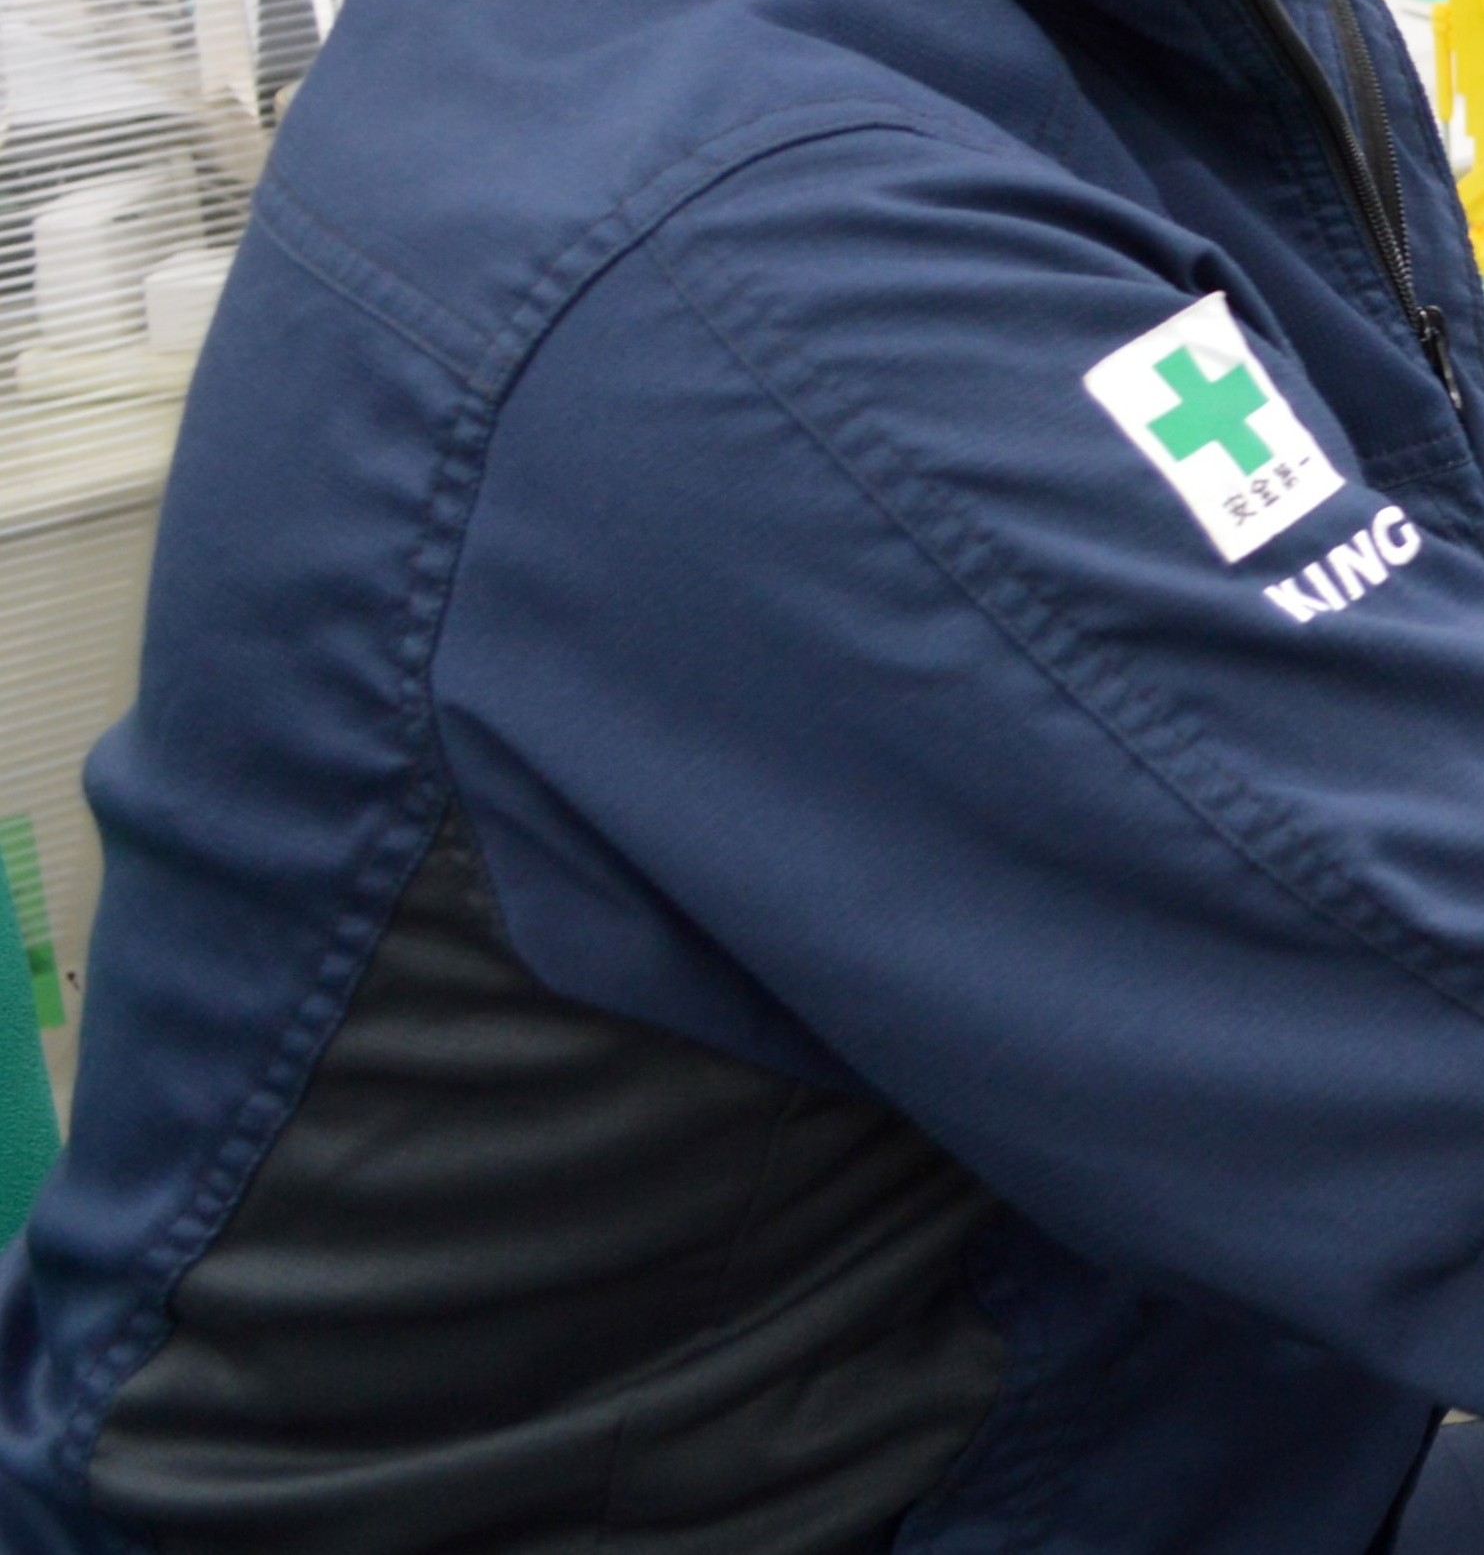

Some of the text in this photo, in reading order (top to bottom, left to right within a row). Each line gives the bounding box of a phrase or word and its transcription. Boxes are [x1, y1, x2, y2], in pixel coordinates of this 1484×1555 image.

[1222, 456, 1311, 527] 安全第一
[1262, 505, 1422, 623] KING
